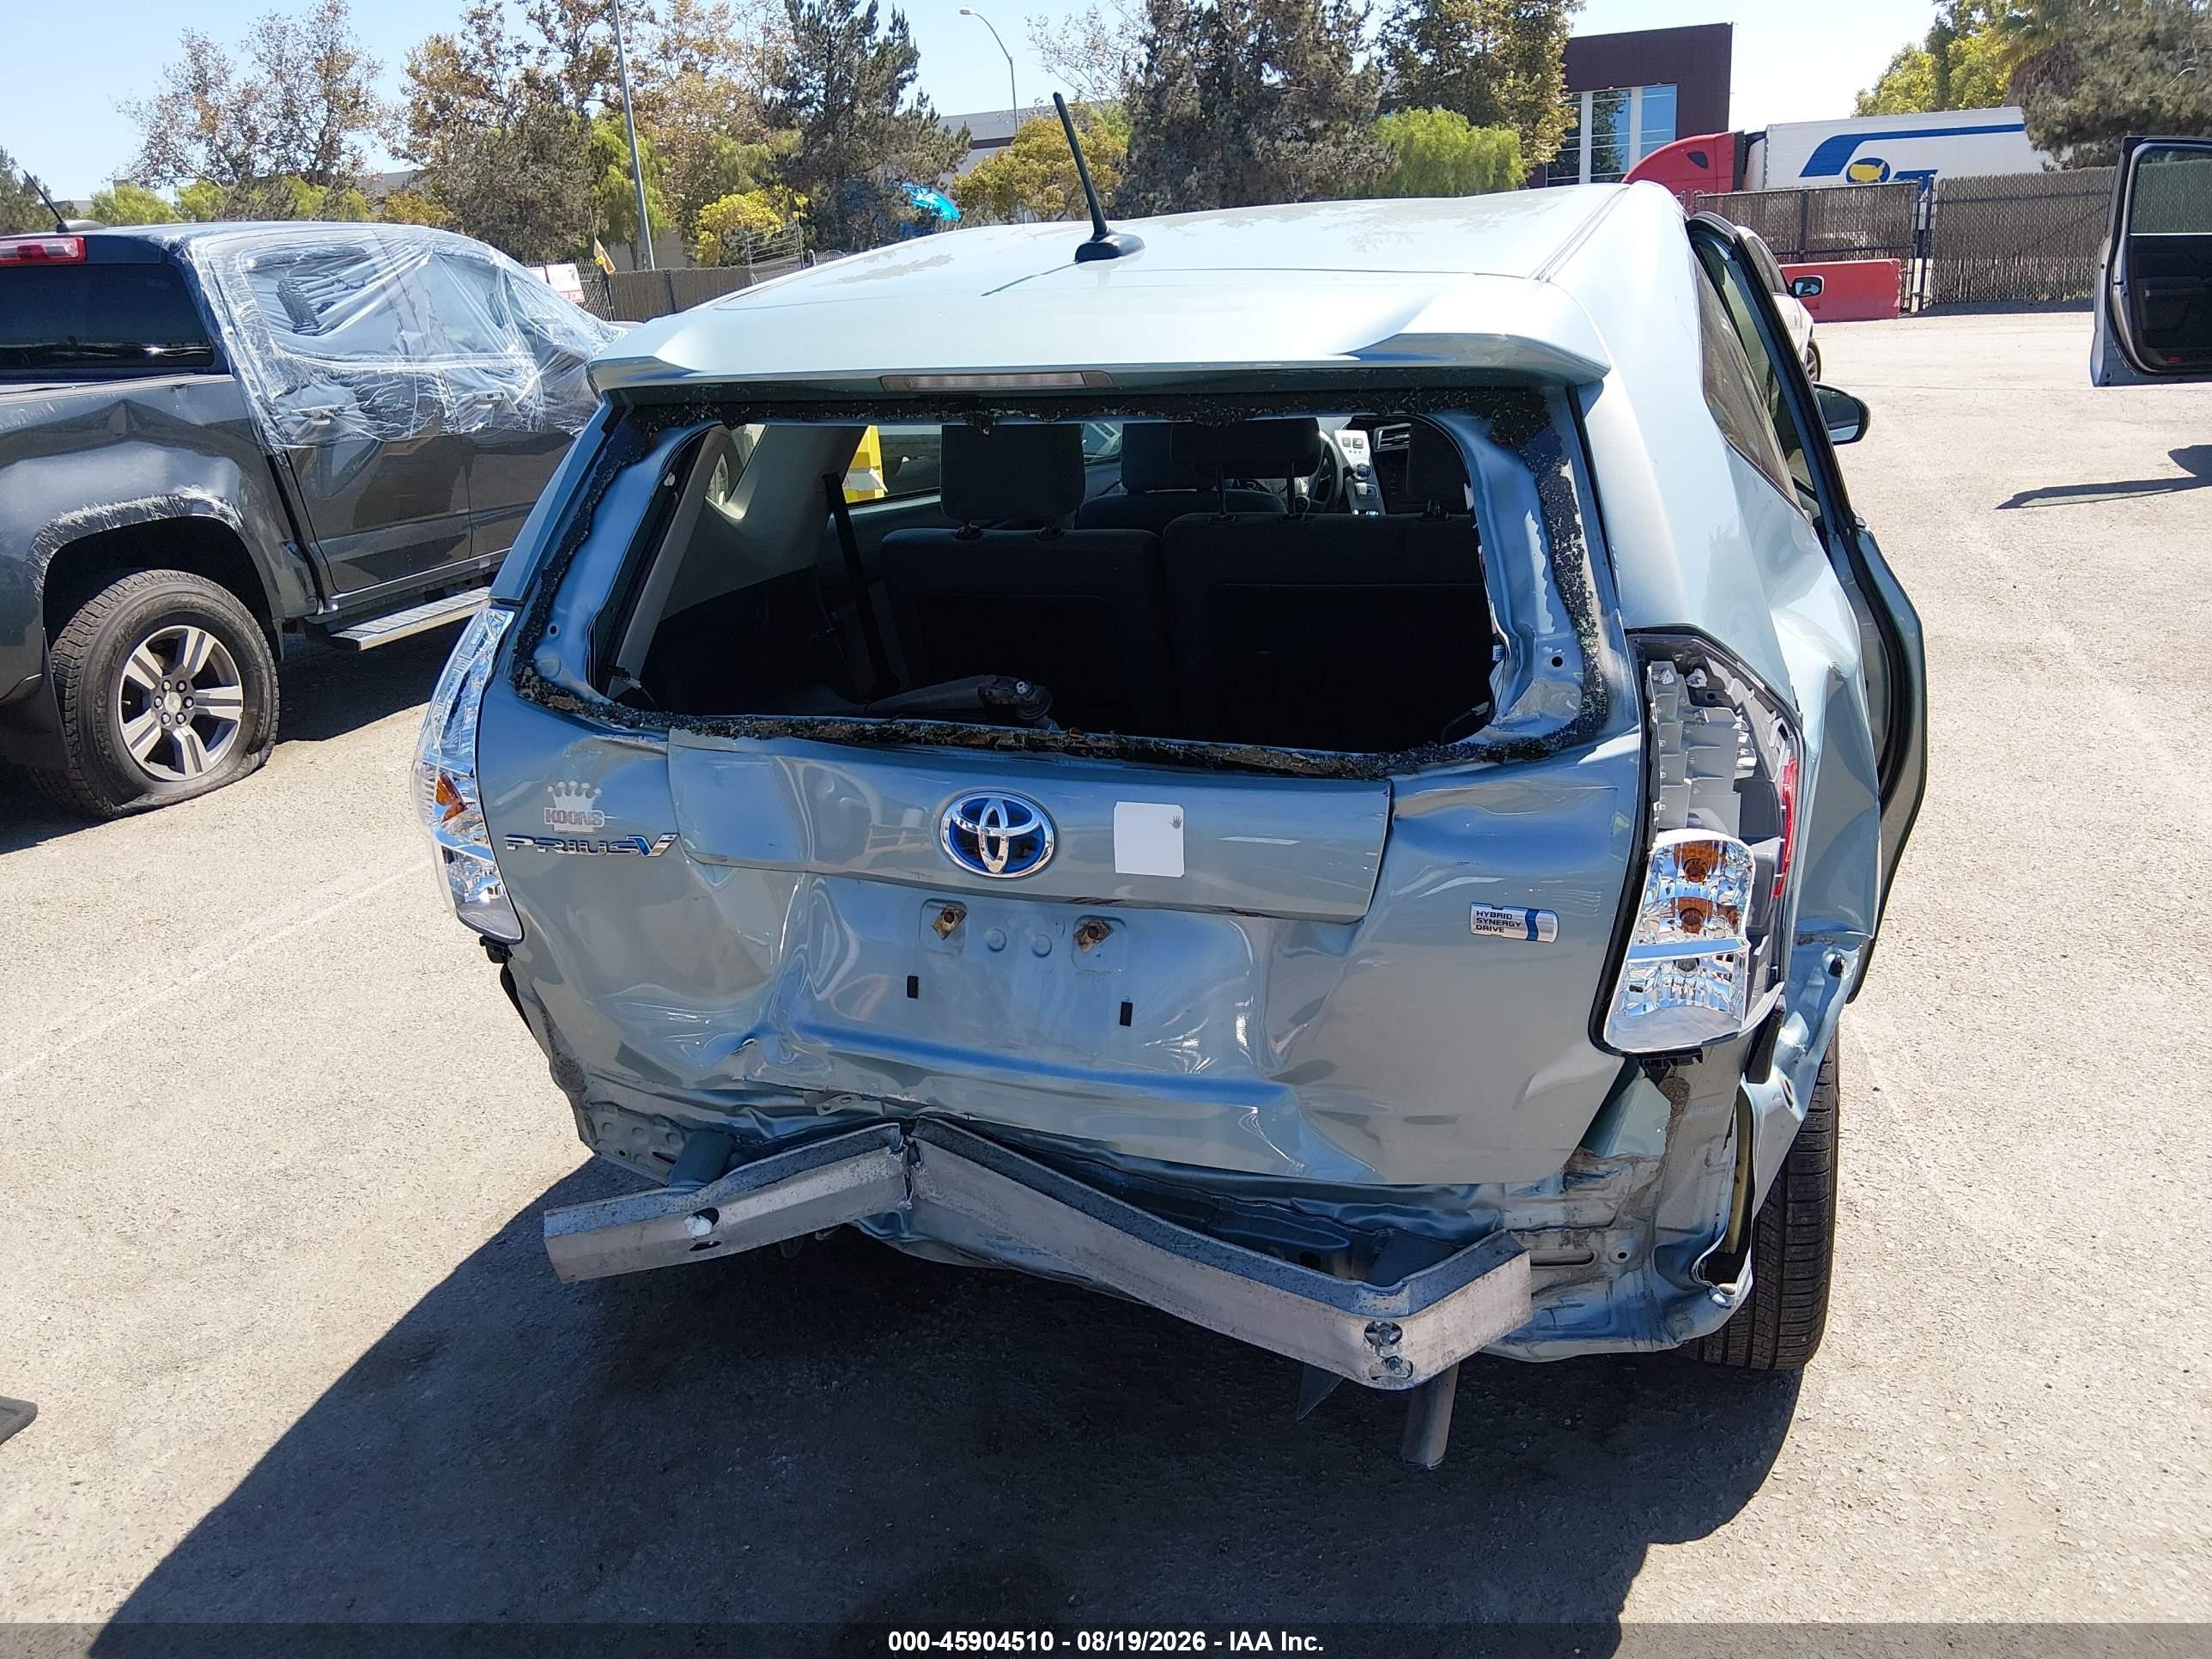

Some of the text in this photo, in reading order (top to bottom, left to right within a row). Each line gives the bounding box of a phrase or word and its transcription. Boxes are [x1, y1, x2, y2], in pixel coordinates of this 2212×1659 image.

[544, 809, 603, 827] KOONS
[1476, 910, 1513, 921] HYBRID
[1476, 917, 1522, 927] SYNERGY
[1475, 924, 1505, 933] DRIVE
